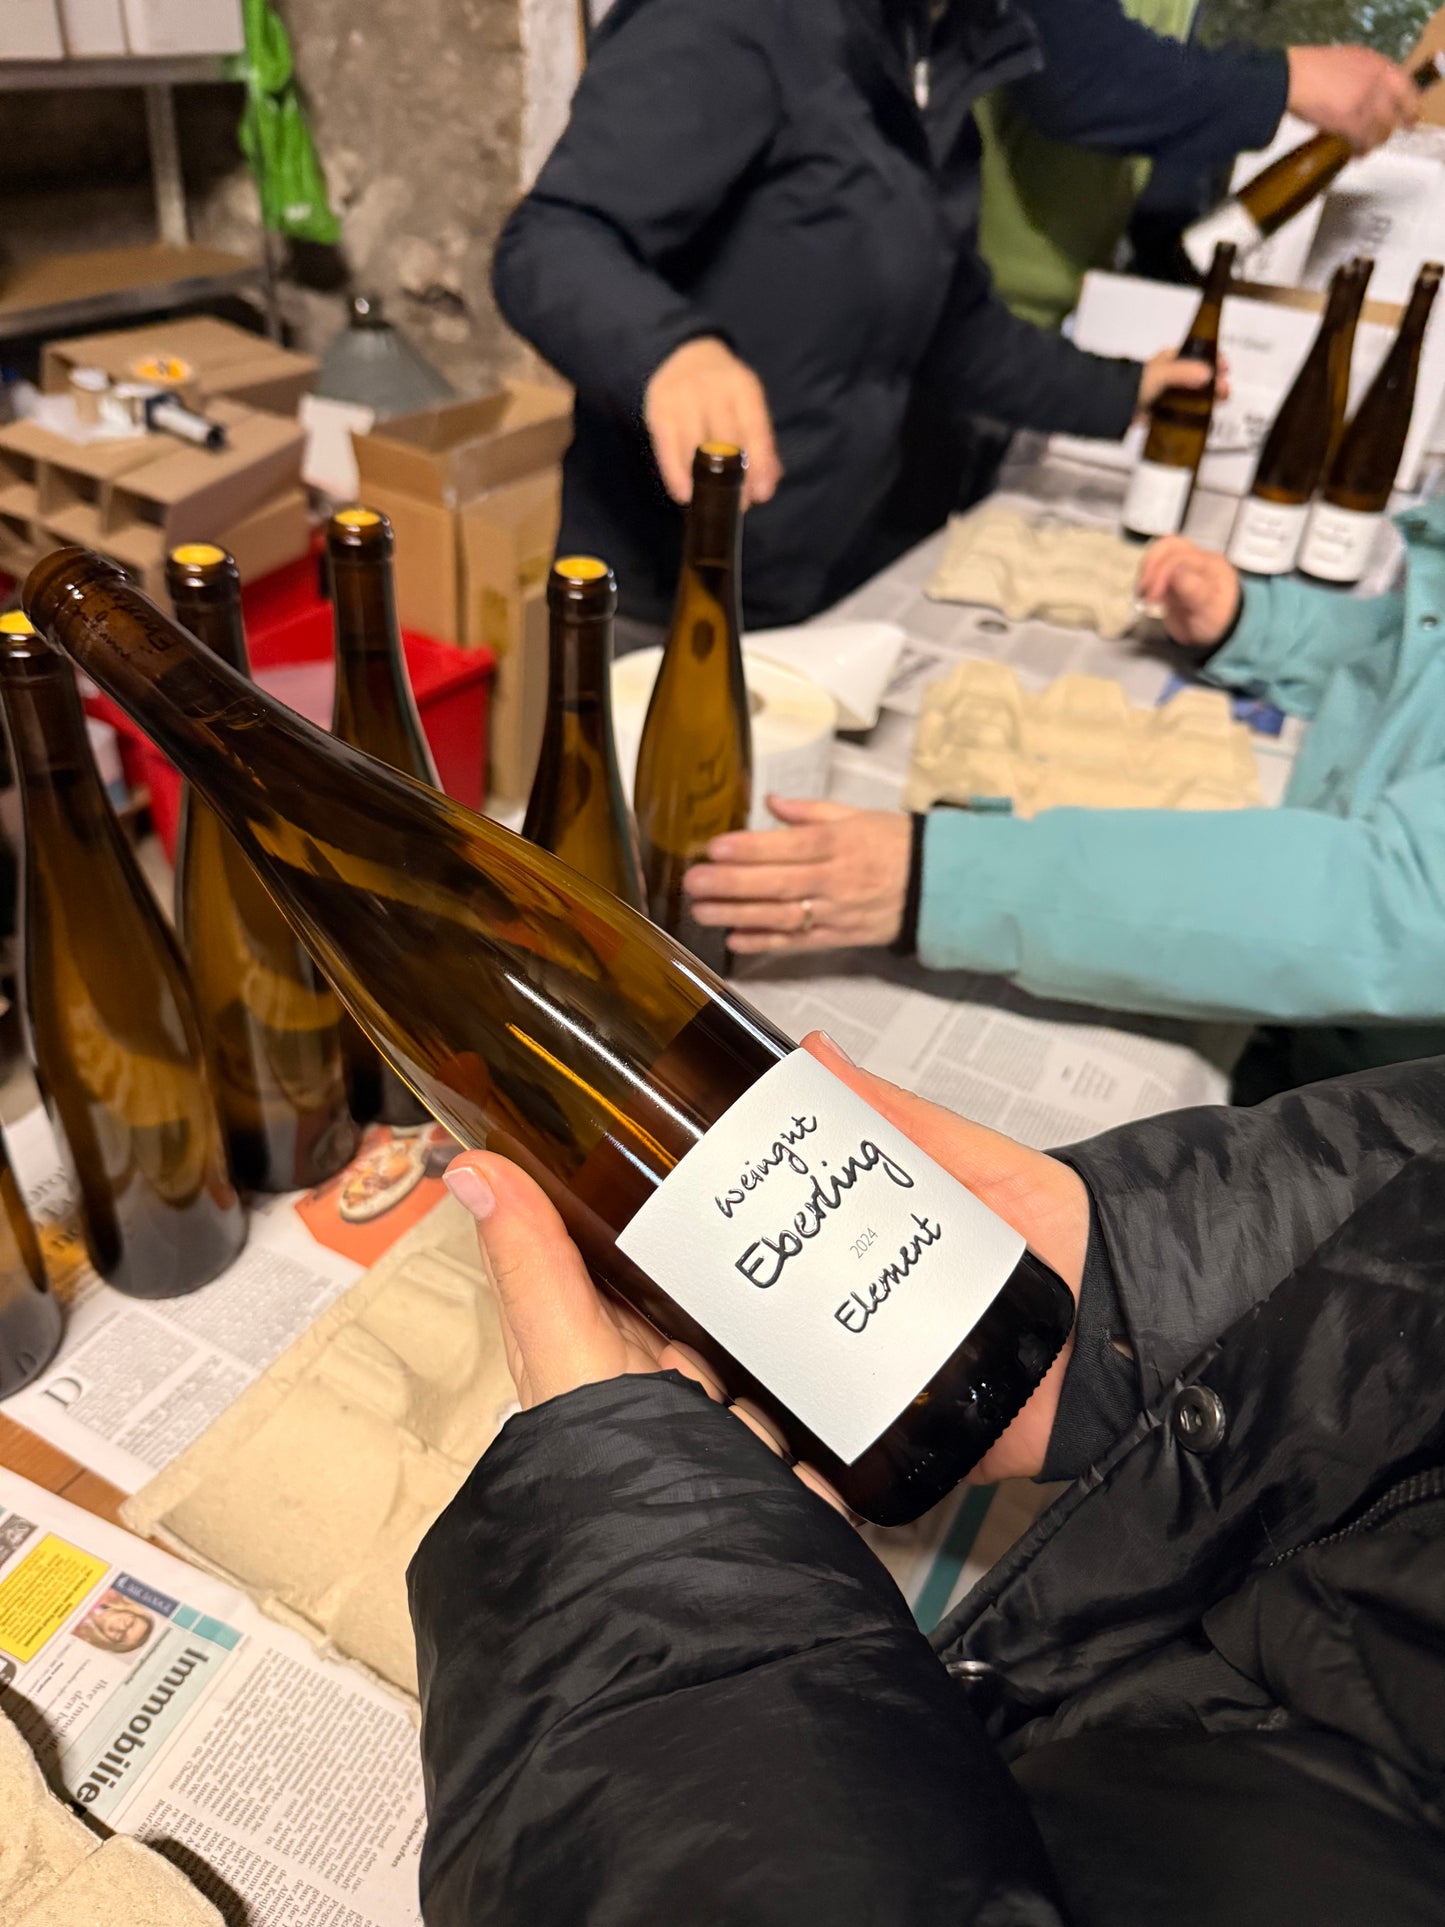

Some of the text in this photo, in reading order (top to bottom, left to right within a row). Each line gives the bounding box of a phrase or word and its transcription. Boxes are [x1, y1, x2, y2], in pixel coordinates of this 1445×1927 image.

[735, 1140, 914, 1288] Eberling
[834, 1213, 941, 1333] Element
[849, 1227, 878, 1259] 2024
